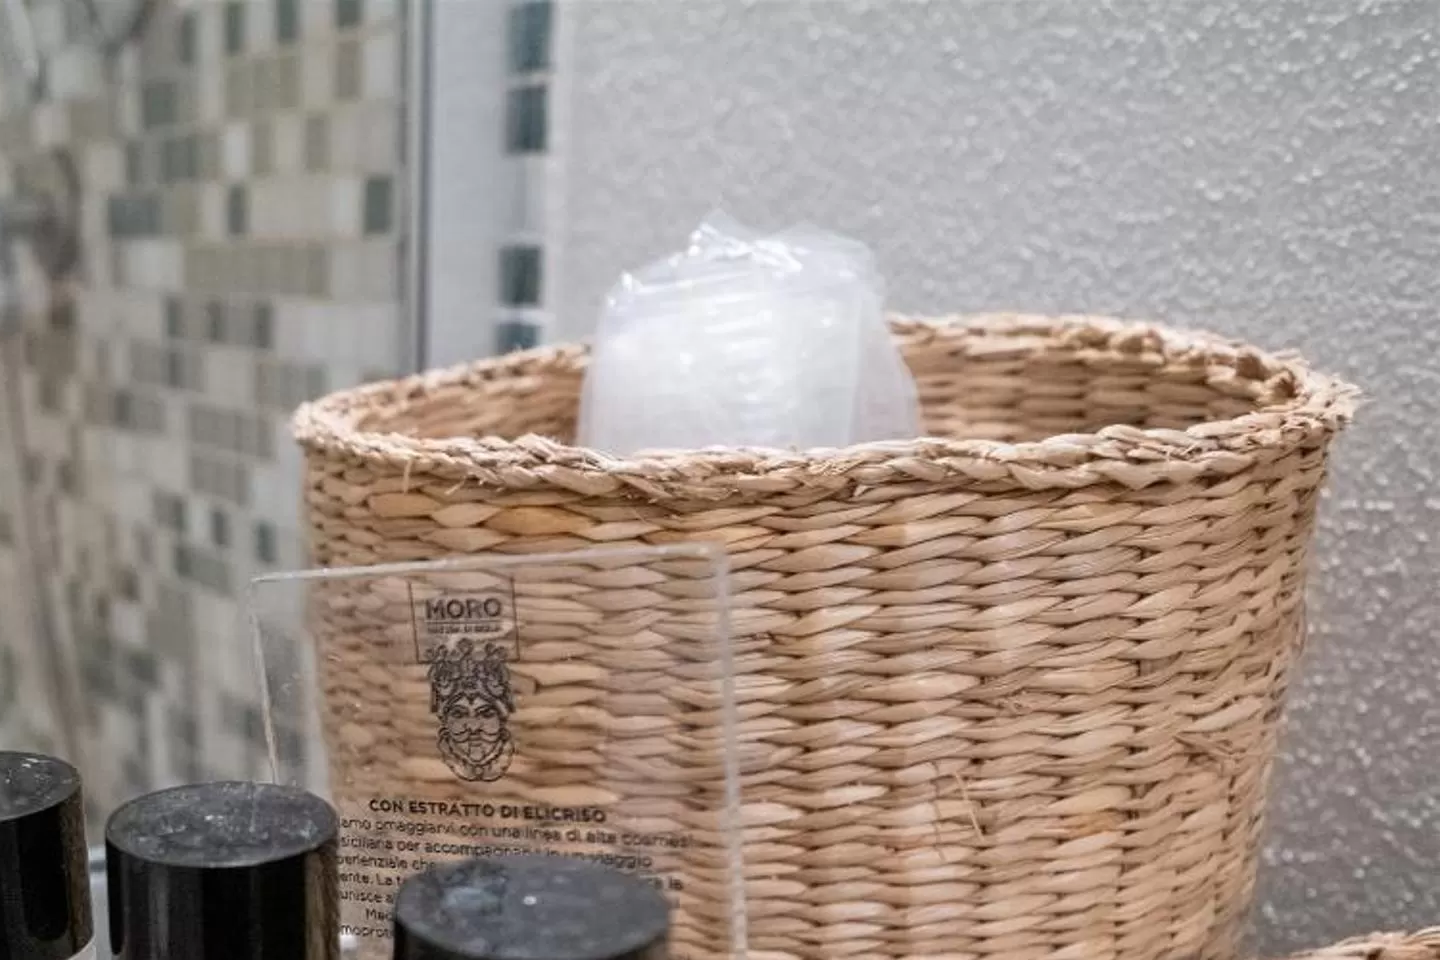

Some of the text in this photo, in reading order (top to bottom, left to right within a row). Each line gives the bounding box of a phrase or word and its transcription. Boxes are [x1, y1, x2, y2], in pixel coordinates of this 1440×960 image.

[426, 598, 502, 619] MORO
[369, 799, 607, 823] CON ESTRATTO DI ELICRISO
[340, 818, 372, 830] amo
[460, 824, 488, 837] con
[397, 839, 421, 852] per
[337, 853, 408, 870] perienziale
